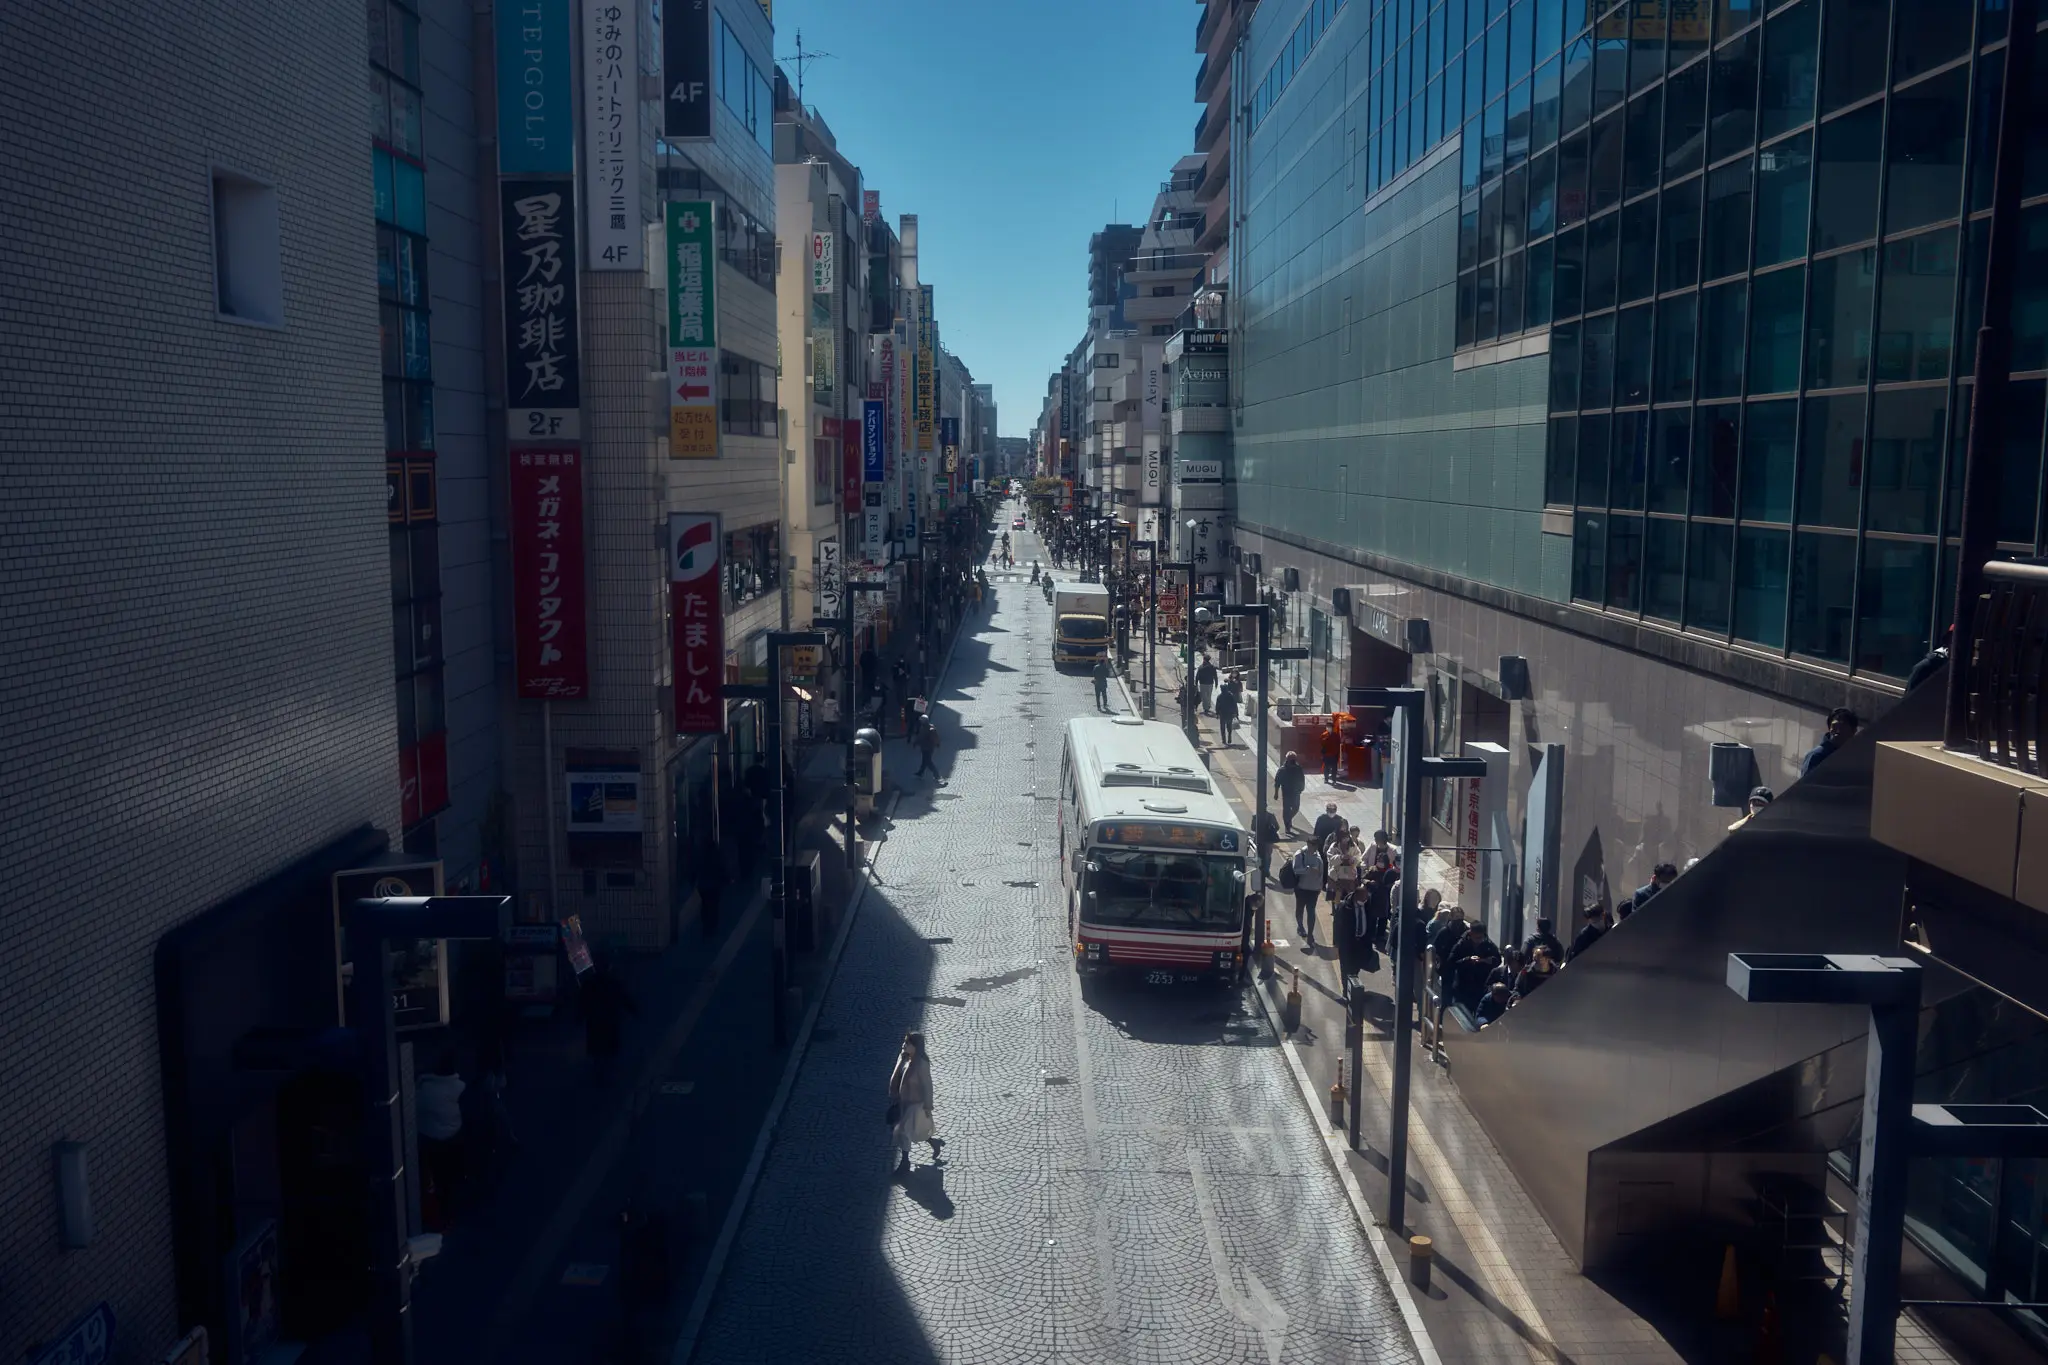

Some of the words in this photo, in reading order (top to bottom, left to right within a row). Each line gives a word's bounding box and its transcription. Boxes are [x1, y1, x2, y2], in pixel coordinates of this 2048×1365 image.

[669, 81, 704, 103] 4F
[604, 5, 626, 230] ゆみのハートクリニック三鷹
[602, 245, 629, 262] 4F
[512, 191, 567, 401] 星乃珈琲店
[674, 351, 710, 363] 当ビル
[679, 366, 708, 378] 1階横
[1180, 366, 1221, 382] Aejon
[1146, 369, 1157, 406] Aejon
[528, 412, 564, 436] 2F
[869, 514, 879, 543] REM
[536, 475, 562, 667] メガネ・コンタクト
[822, 546, 838, 605] とんかつ
[683, 592, 713, 705] たましん
